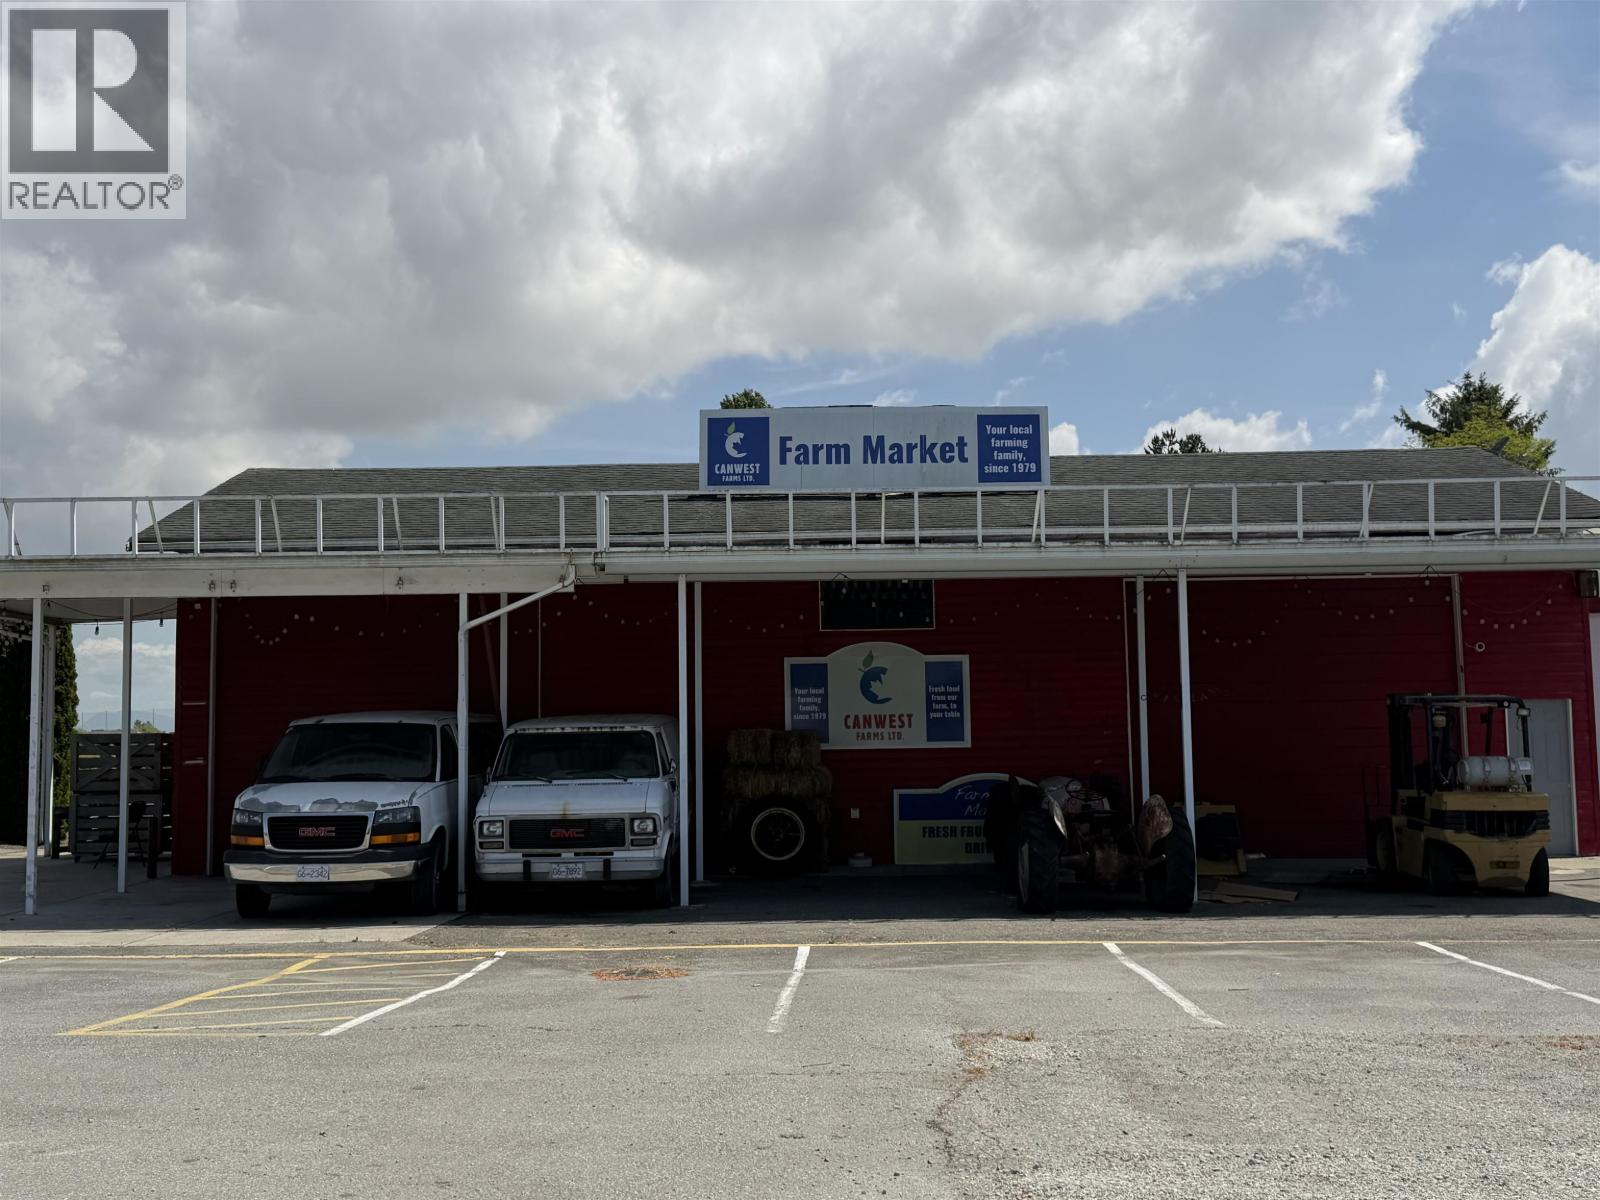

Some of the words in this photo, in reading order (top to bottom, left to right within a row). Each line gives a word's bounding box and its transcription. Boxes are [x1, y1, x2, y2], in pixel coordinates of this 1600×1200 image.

[985, 424, 1007, 435] Your
[1009, 424, 1033, 435] local
[990, 437, 1028, 449] farming
[779, 436, 851, 465] Farm
[862, 434, 969, 465] Market
[993, 450, 1026, 462] family,
[714, 463, 761, 474] CANWEST
[983, 463, 1009, 473] since
[1012, 462, 1037, 473] 1979
[794, 687, 808, 695] Your
[809, 687, 825, 695] local
[928, 685, 946, 693] Fresh
[946, 684, 960, 692] food
[797, 696, 822, 704] farming
[799, 704, 821, 712] family,
[793, 712, 810, 720] since
[811, 711, 827, 720] 1979
[929, 711, 943, 720] your
[944, 710, 961, 718] table
[844, 713, 914, 729] CANWEST
[856, 731, 885, 741] FARMS
[888, 731, 905, 741] LTD.
[298, 826, 336, 837] GMC
[550, 828, 585, 838] GMC
[922, 826, 957, 838] FRESH
